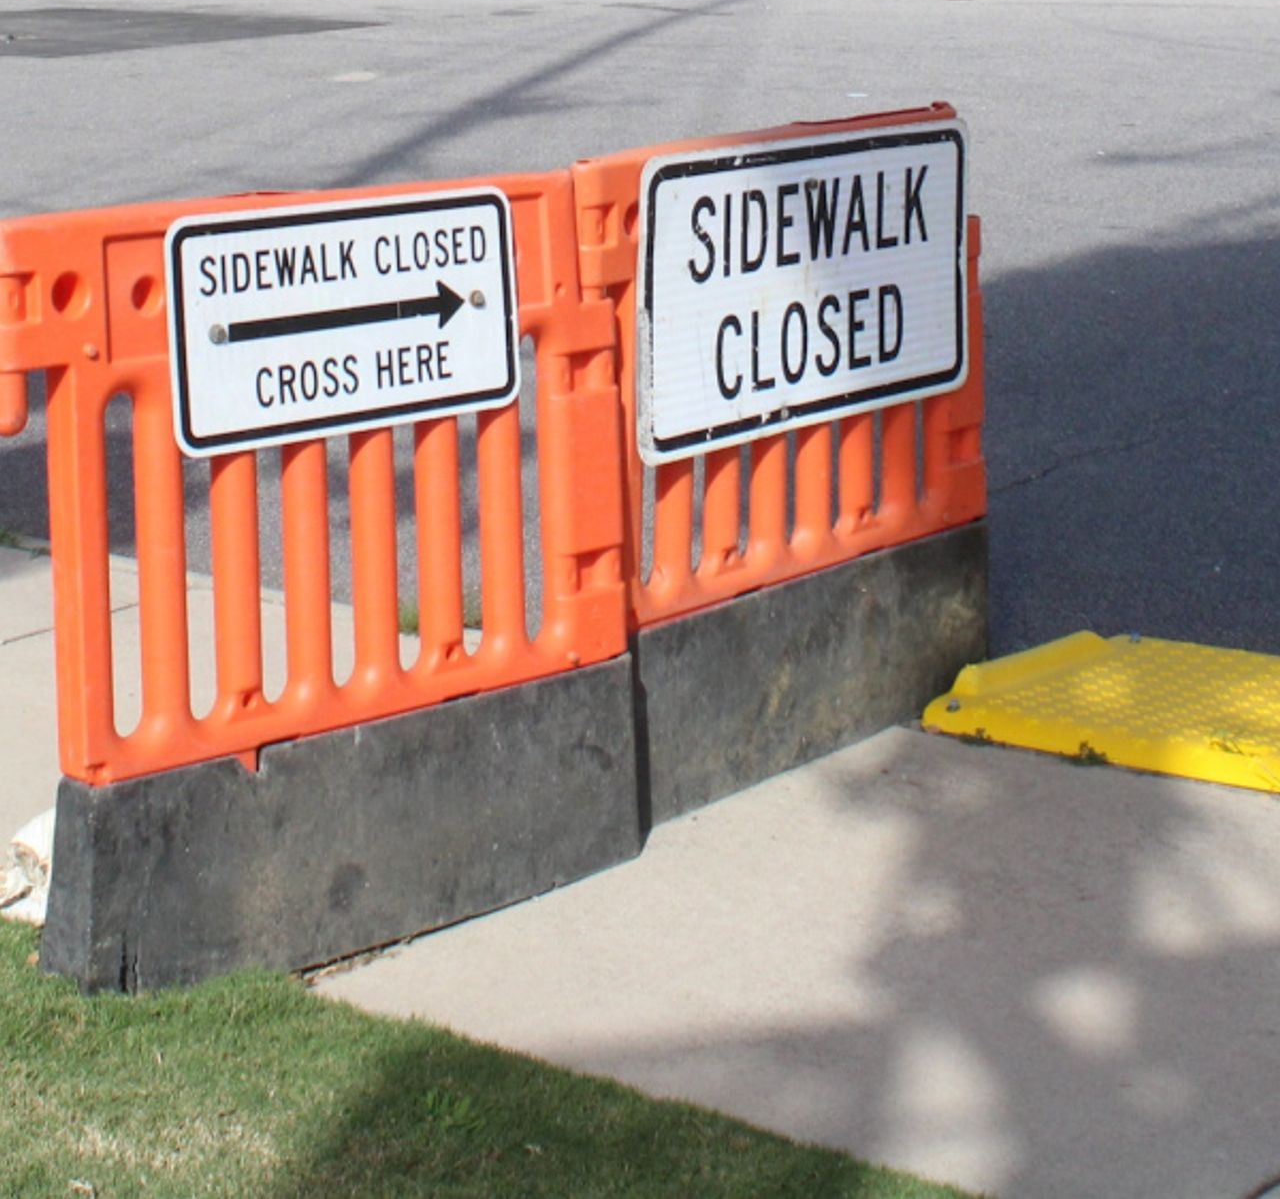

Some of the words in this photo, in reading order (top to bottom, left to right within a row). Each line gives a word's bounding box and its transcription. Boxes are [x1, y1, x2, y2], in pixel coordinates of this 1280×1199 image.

[199, 238, 358, 297] SIDEWALK
[374, 224, 488, 276] CLOSED
[687, 165, 930, 285] SIDEWALK
[256, 353, 360, 408] CROSS
[376, 340, 453, 391] HERE
[716, 283, 904, 401] CLOSED
